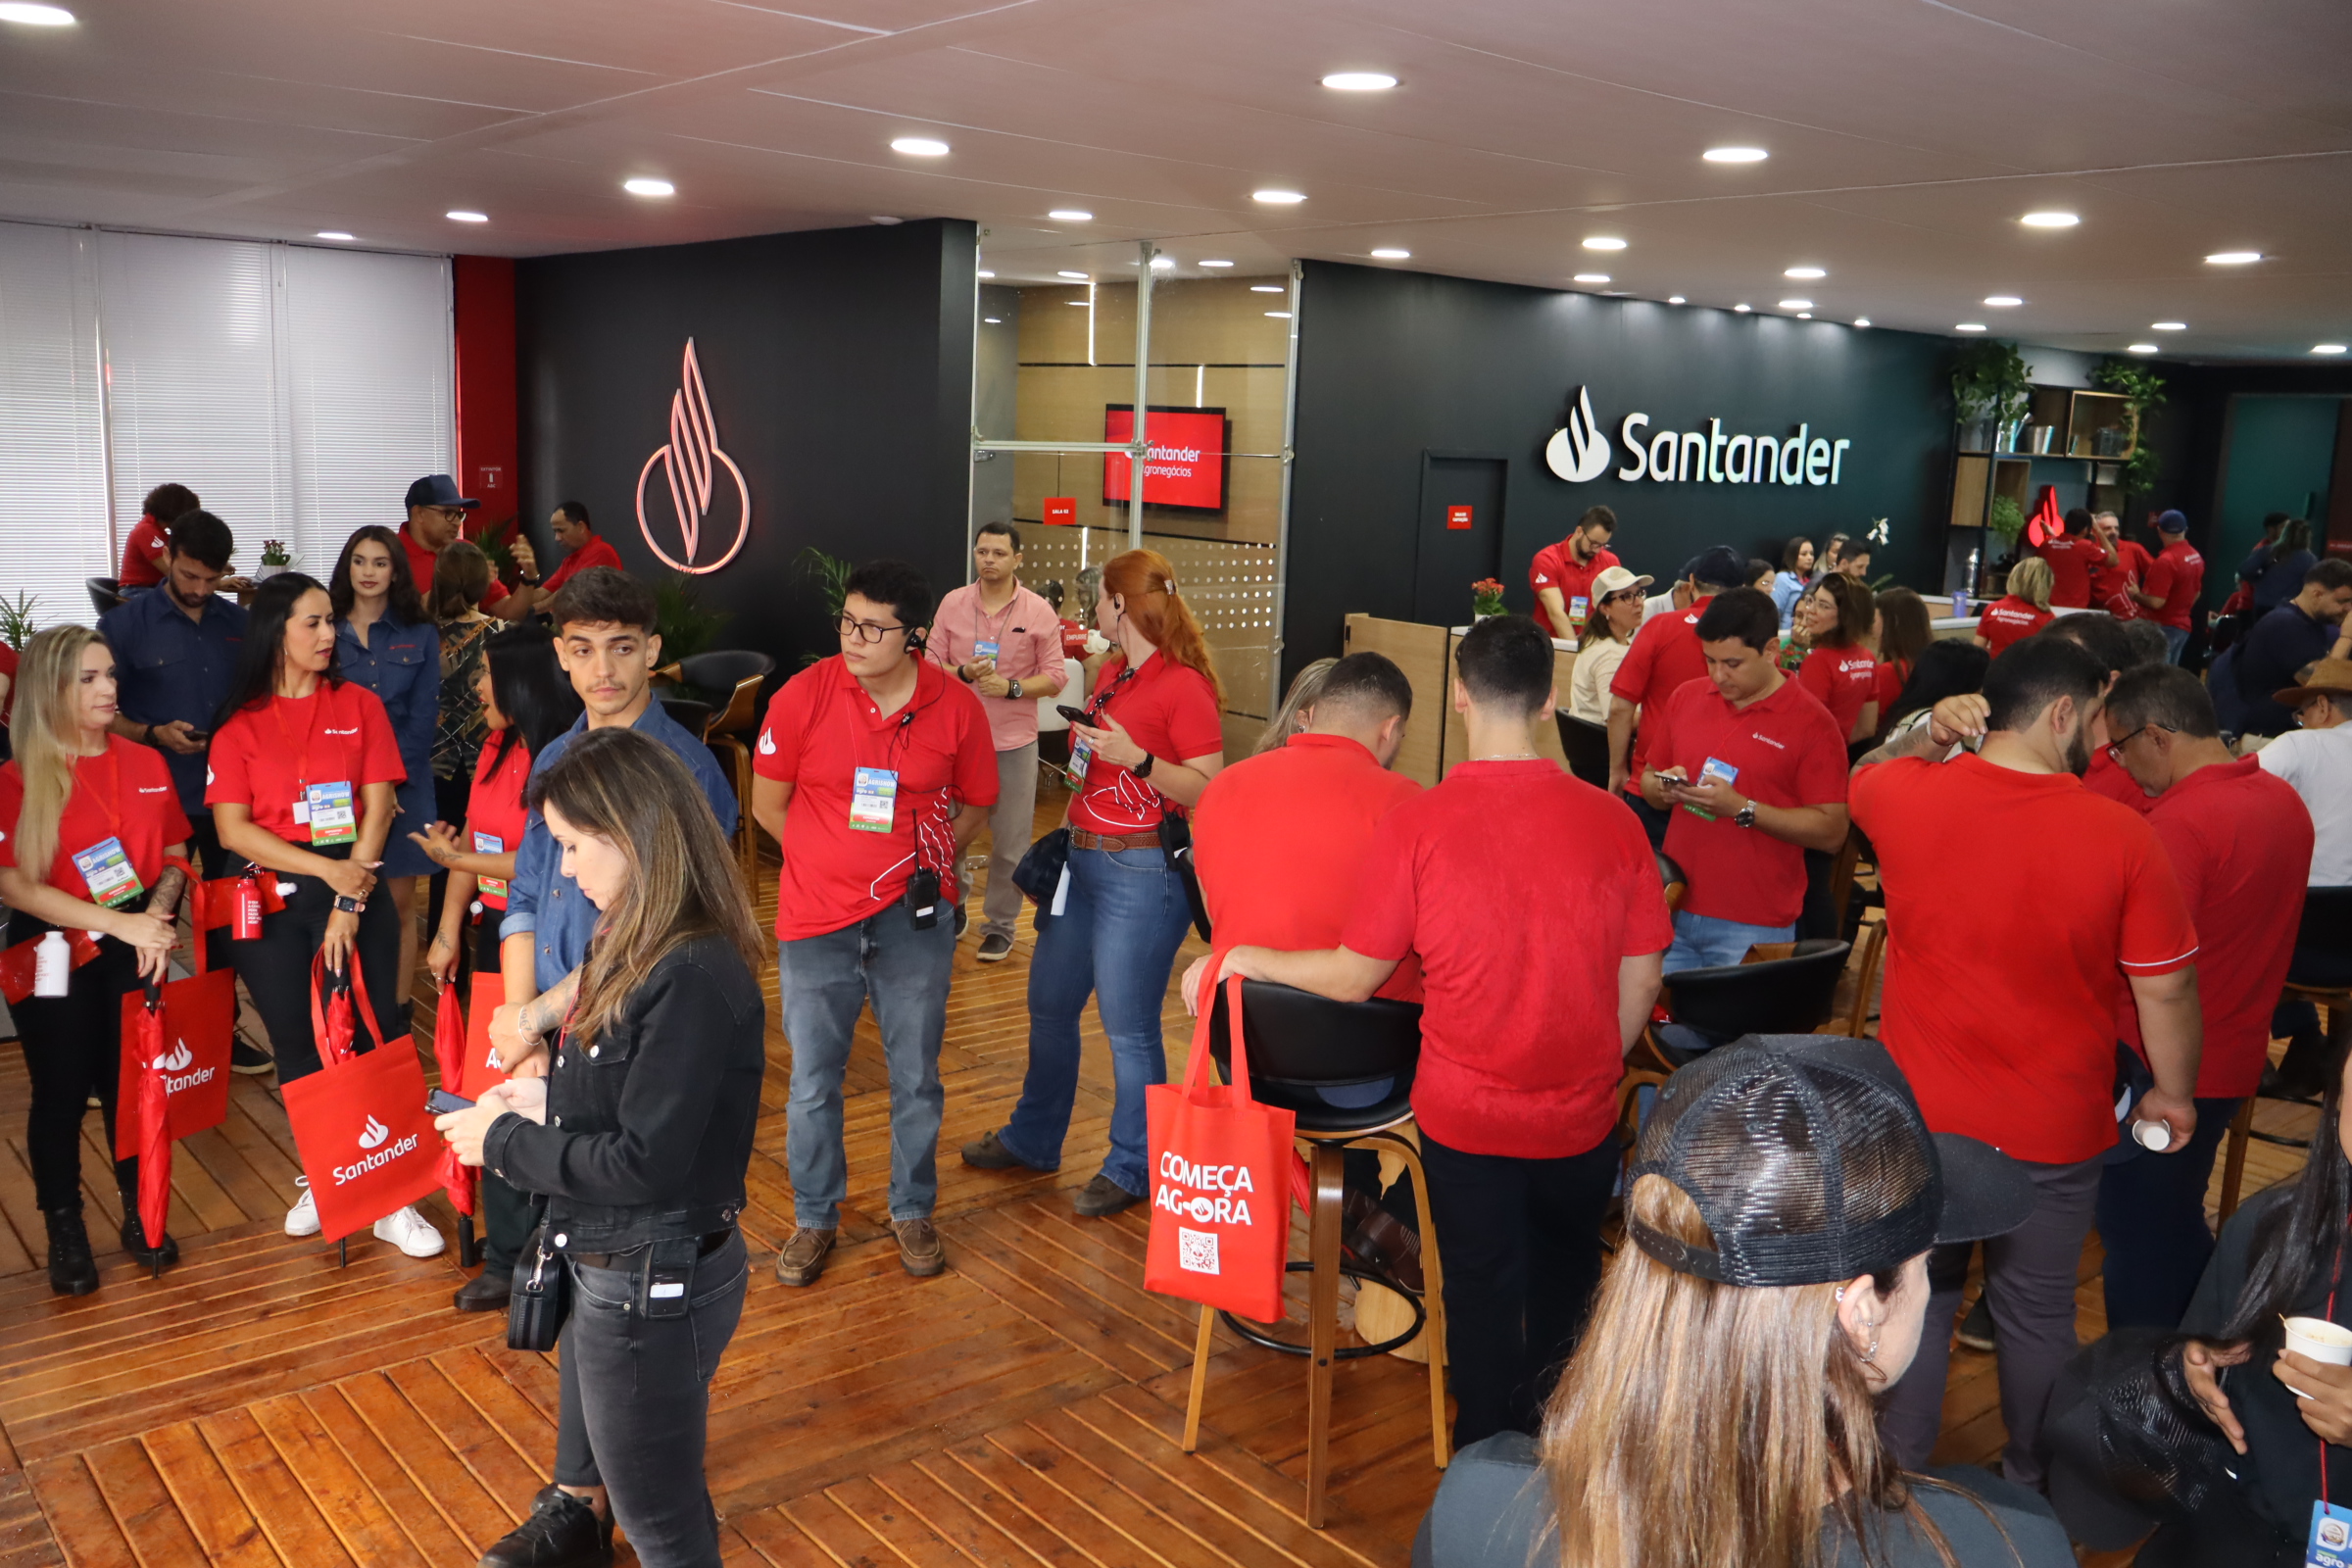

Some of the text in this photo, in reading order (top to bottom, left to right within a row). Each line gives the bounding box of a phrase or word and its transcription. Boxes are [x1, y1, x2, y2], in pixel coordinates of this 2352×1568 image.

[1144, 444, 1200, 463] antander
[1618, 412, 1850, 486] Santander
[1143, 465, 1193, 478] gronegócios
[1758, 734, 1786, 750] Santander
[166, 1066, 216, 1094] tander
[332, 1133, 418, 1186] Santander
[1159, 1151, 1254, 1198] COMEÇA
